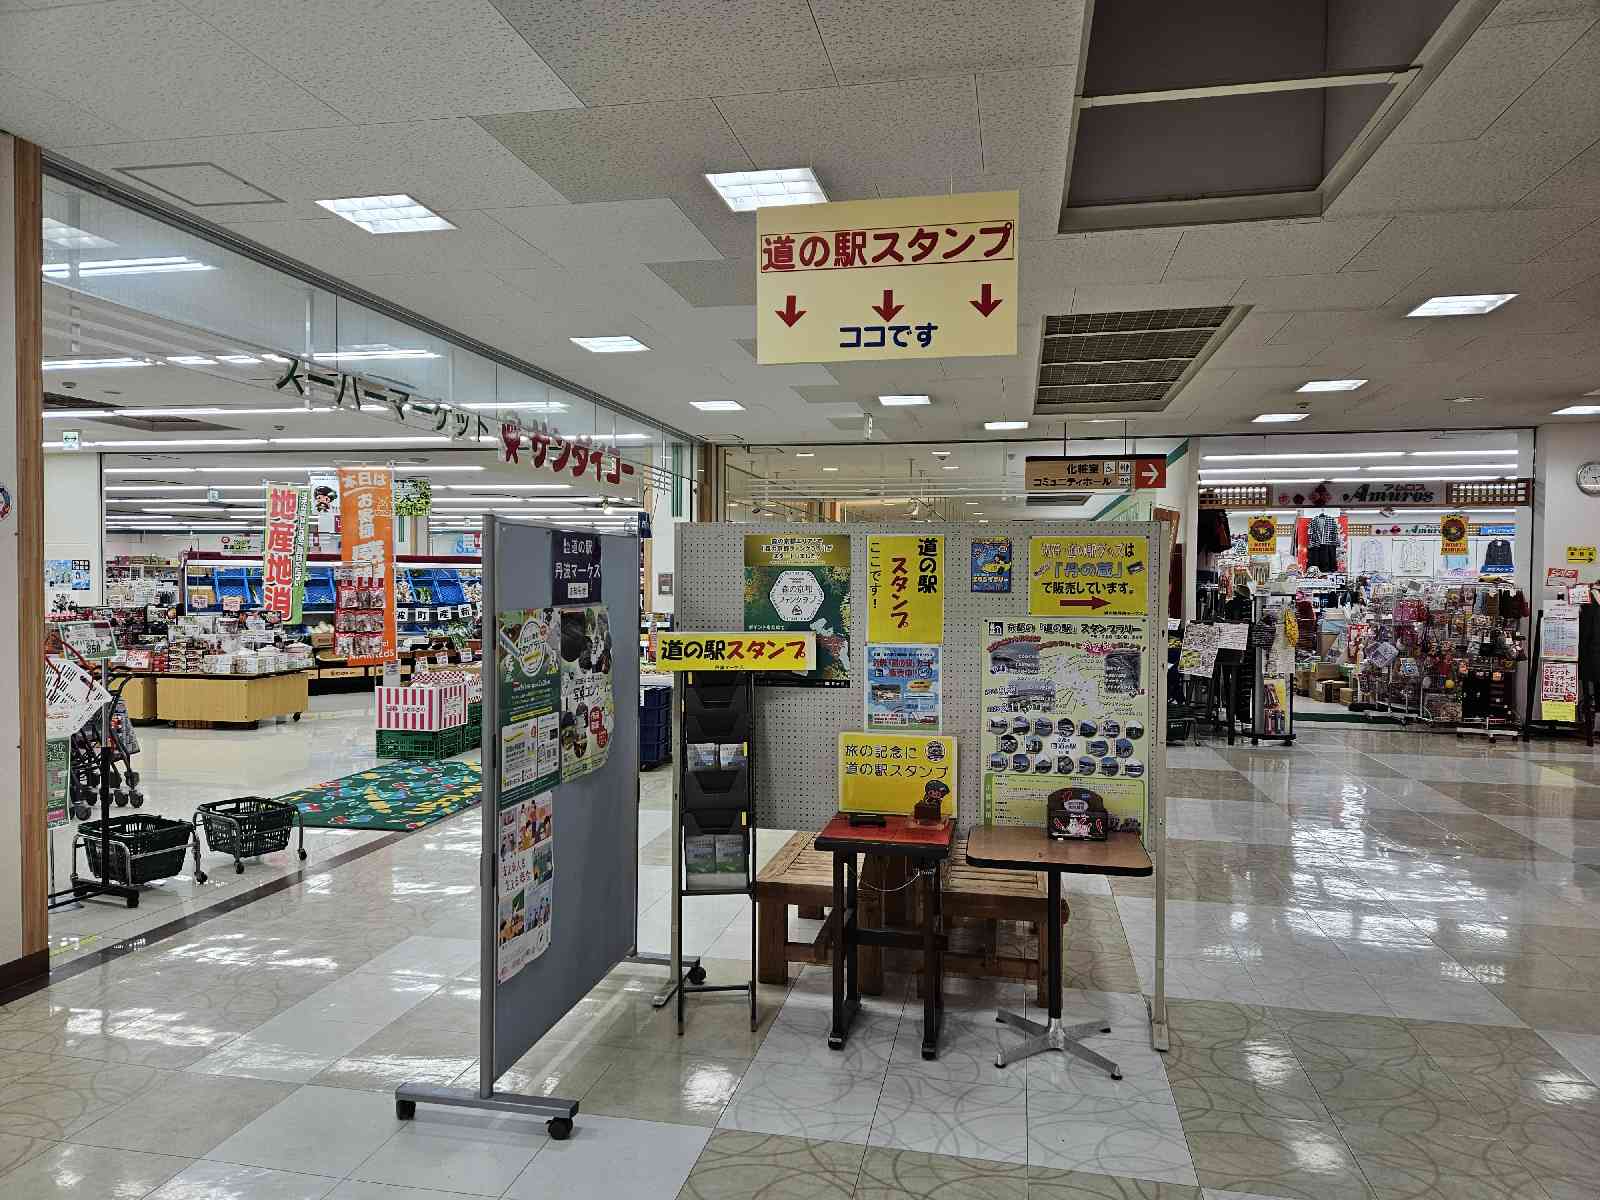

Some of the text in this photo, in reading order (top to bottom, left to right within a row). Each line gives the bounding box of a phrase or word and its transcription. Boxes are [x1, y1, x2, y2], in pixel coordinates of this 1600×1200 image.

[762, 222, 1013, 271] 道の駅スタンプ
[839, 322, 938, 348] ココです
[1067, 463, 1099, 475] 化粧室
[1033, 477, 1112, 487] コミュニティホール
[1347, 483, 1434, 502] Amuros
[571, 539, 593, 555] 道の駅
[555, 562, 600, 580] 丹波マーケス
[917, 537, 938, 594] 道の駅
[891, 557, 909, 629] スタンプ
[1041, 581, 1134, 595] で販売しています。
[661, 640, 806, 661] 道の駅スタンプ
[845, 744, 917, 760] 旅の記念に
